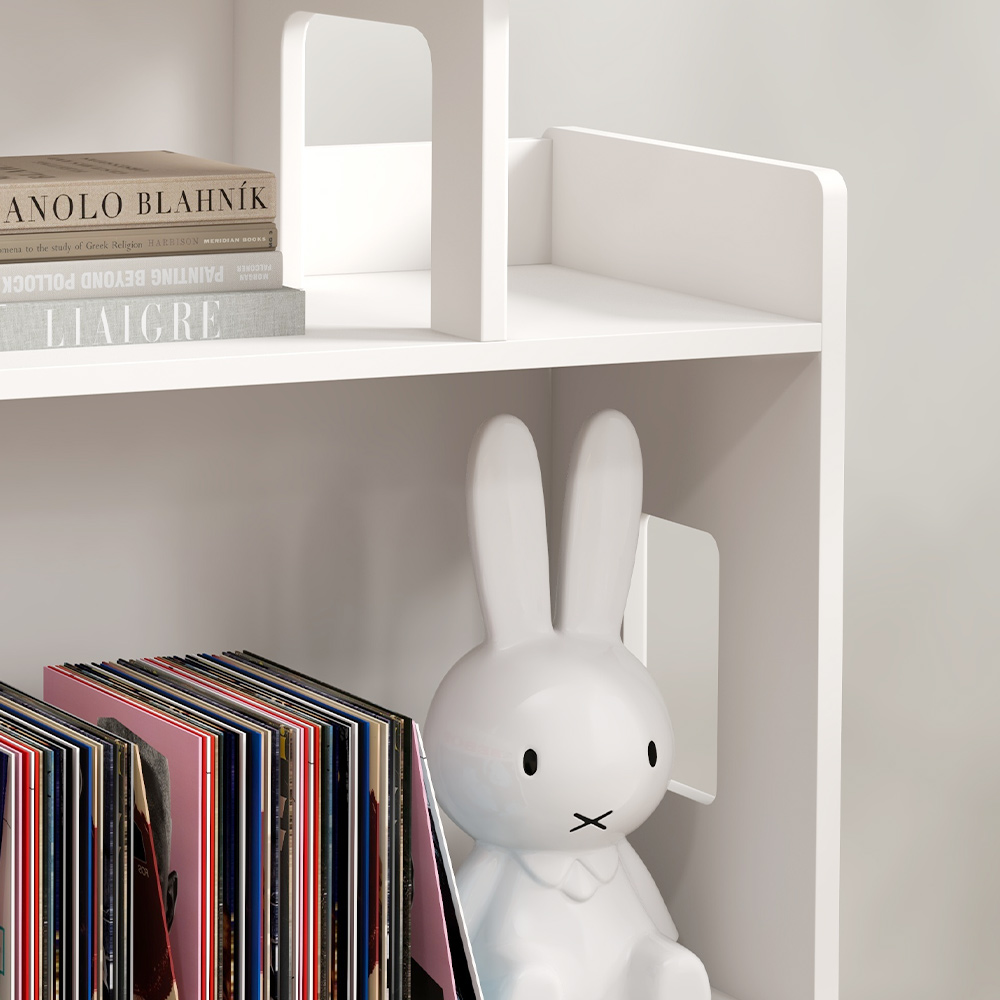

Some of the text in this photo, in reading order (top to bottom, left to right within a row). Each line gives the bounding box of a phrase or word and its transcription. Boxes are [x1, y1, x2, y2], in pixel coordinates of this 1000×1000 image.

[136, 180, 268, 215] BLAHNÍK
[36, 243, 49, 253] the
[51, 242, 72, 254] study
[74, 241, 84, 250] of
[85, 240, 108, 250] Greek
[111, 239, 143, 252] Religion
[148, 237, 200, 247] HARRISON
[236, 264, 272, 272] FALCONER
[1, 265, 224, 294] PAINTING BEYOND POLLOCK
[239, 273, 269, 281] MORGAN
[46, 300, 220, 348] LIAIGRE
